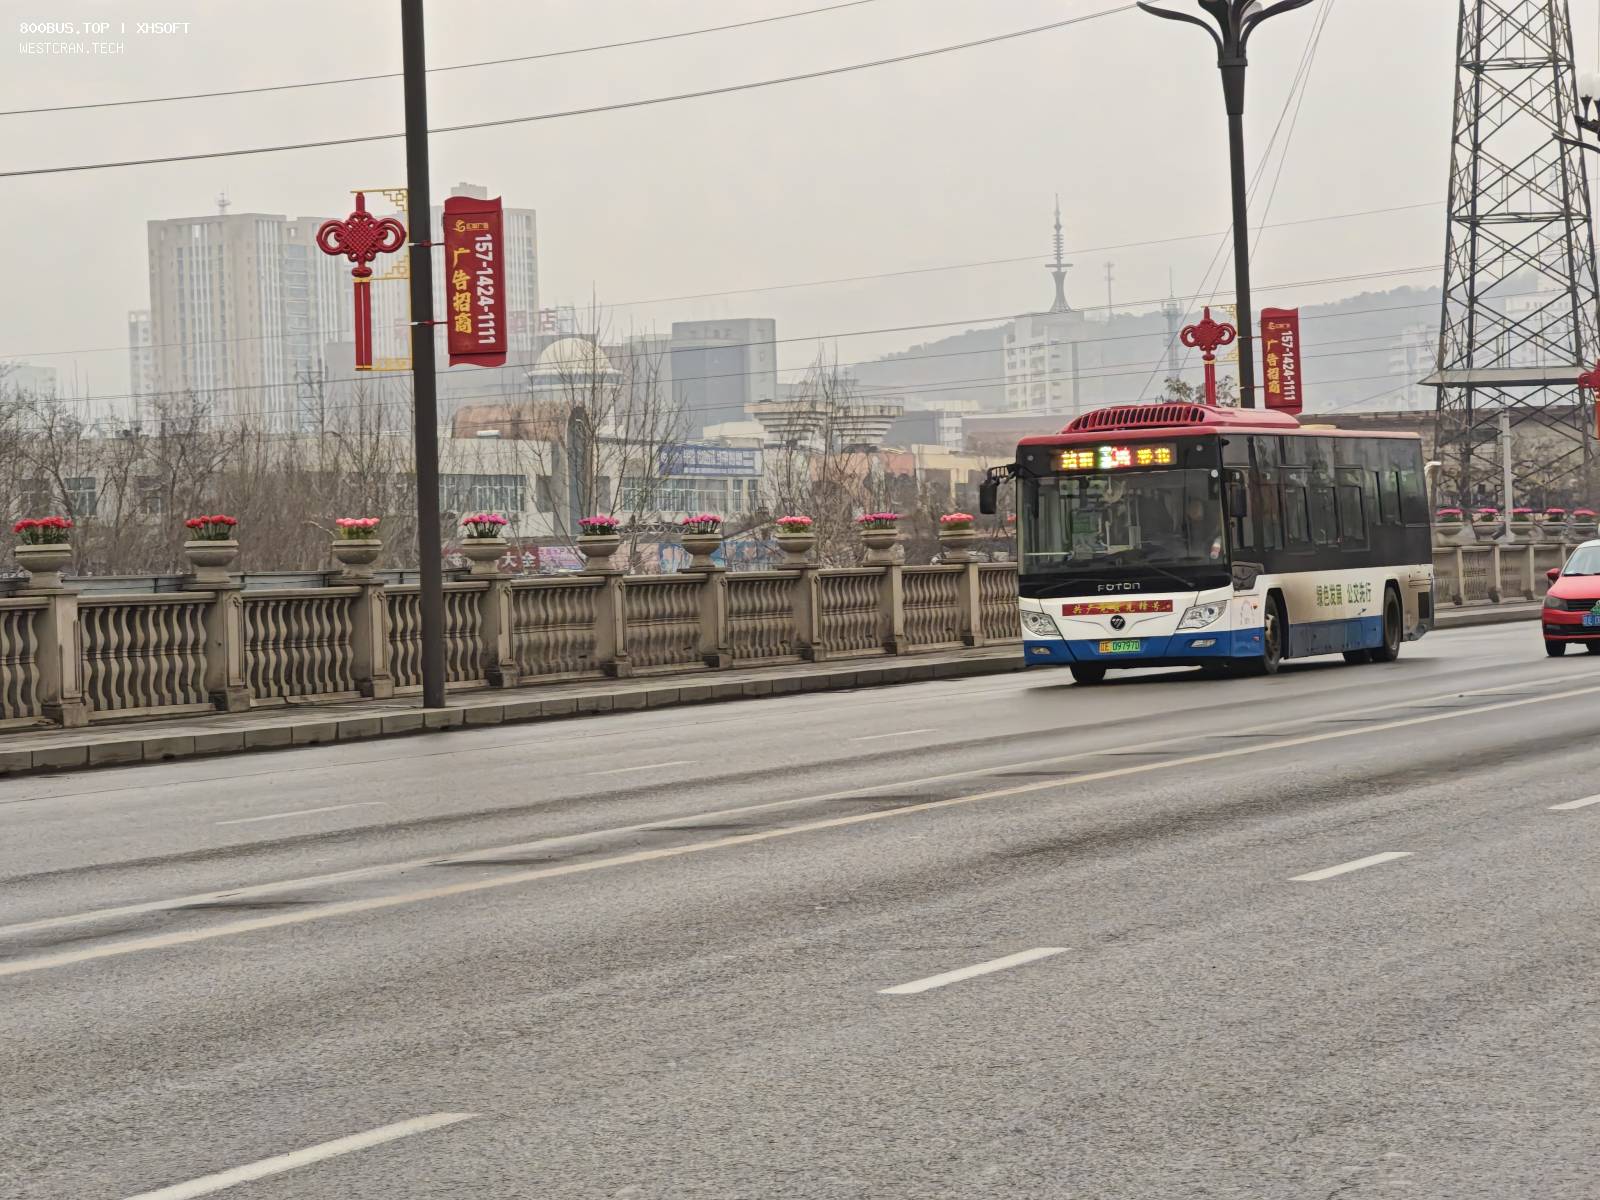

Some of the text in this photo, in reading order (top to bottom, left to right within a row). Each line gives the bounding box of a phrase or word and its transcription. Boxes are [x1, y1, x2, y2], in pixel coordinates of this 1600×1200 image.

[451, 247, 473, 335] 广告招商
[473, 233, 497, 345] 157-1424-1111
[1265, 338, 1281, 394] 广告招商
[1281, 330, 1296, 401] 157-1424-1111
[1097, 582, 1141, 592] FOTON
